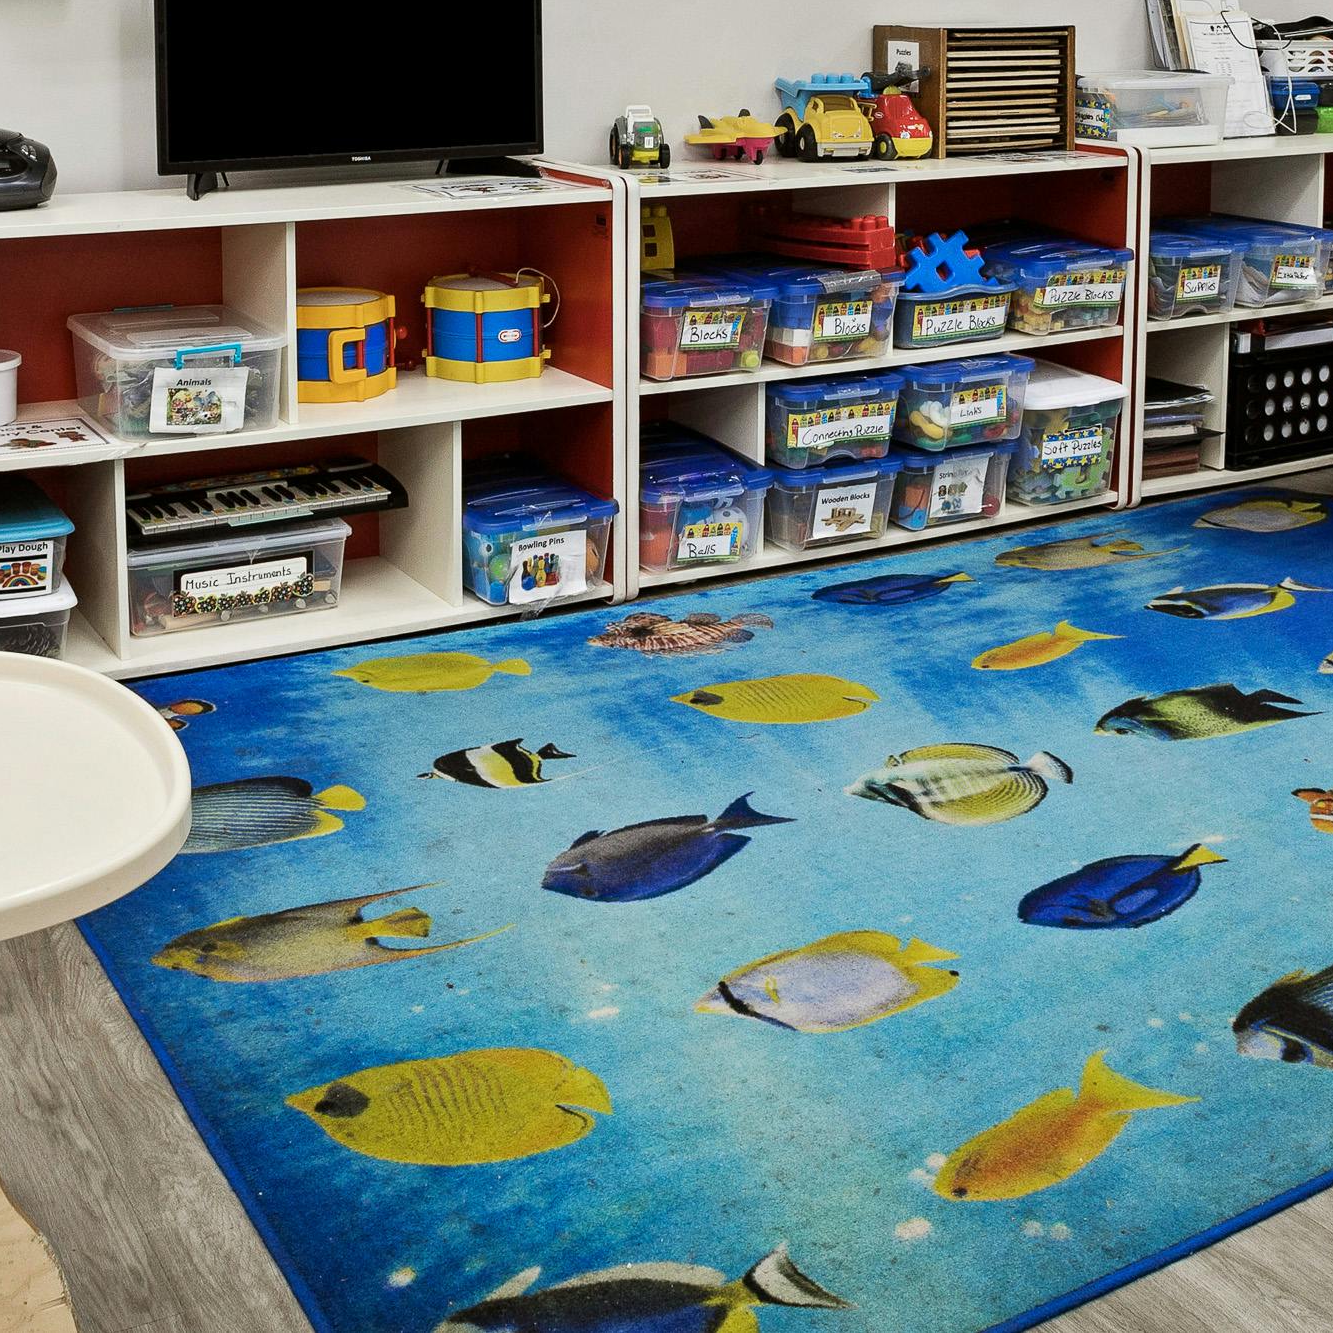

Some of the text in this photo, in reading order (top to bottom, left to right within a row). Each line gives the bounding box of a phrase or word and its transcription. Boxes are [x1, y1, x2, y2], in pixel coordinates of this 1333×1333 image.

[1050, 288, 1115, 303] Puzzle Blocks
[834, 318, 866, 336] Blocks
[926, 315, 996, 335] Puzzle Blocks
[690, 326, 728, 343] Blocks
[176, 378, 212, 387] Animals
[960, 406, 982, 418] Links
[25, 425, 83, 437] Center
[801, 423, 884, 446] Connecting Puzzle
[1043, 437, 1103, 457] Soft Puzzles
[821, 492, 870, 505] Wooden Blocks
[18, 541, 49, 554] Dough
[518, 536, 565, 552] Bowling Pins
[687, 542, 717, 558] Balls
[185, 566, 292, 591] Music Instruments
